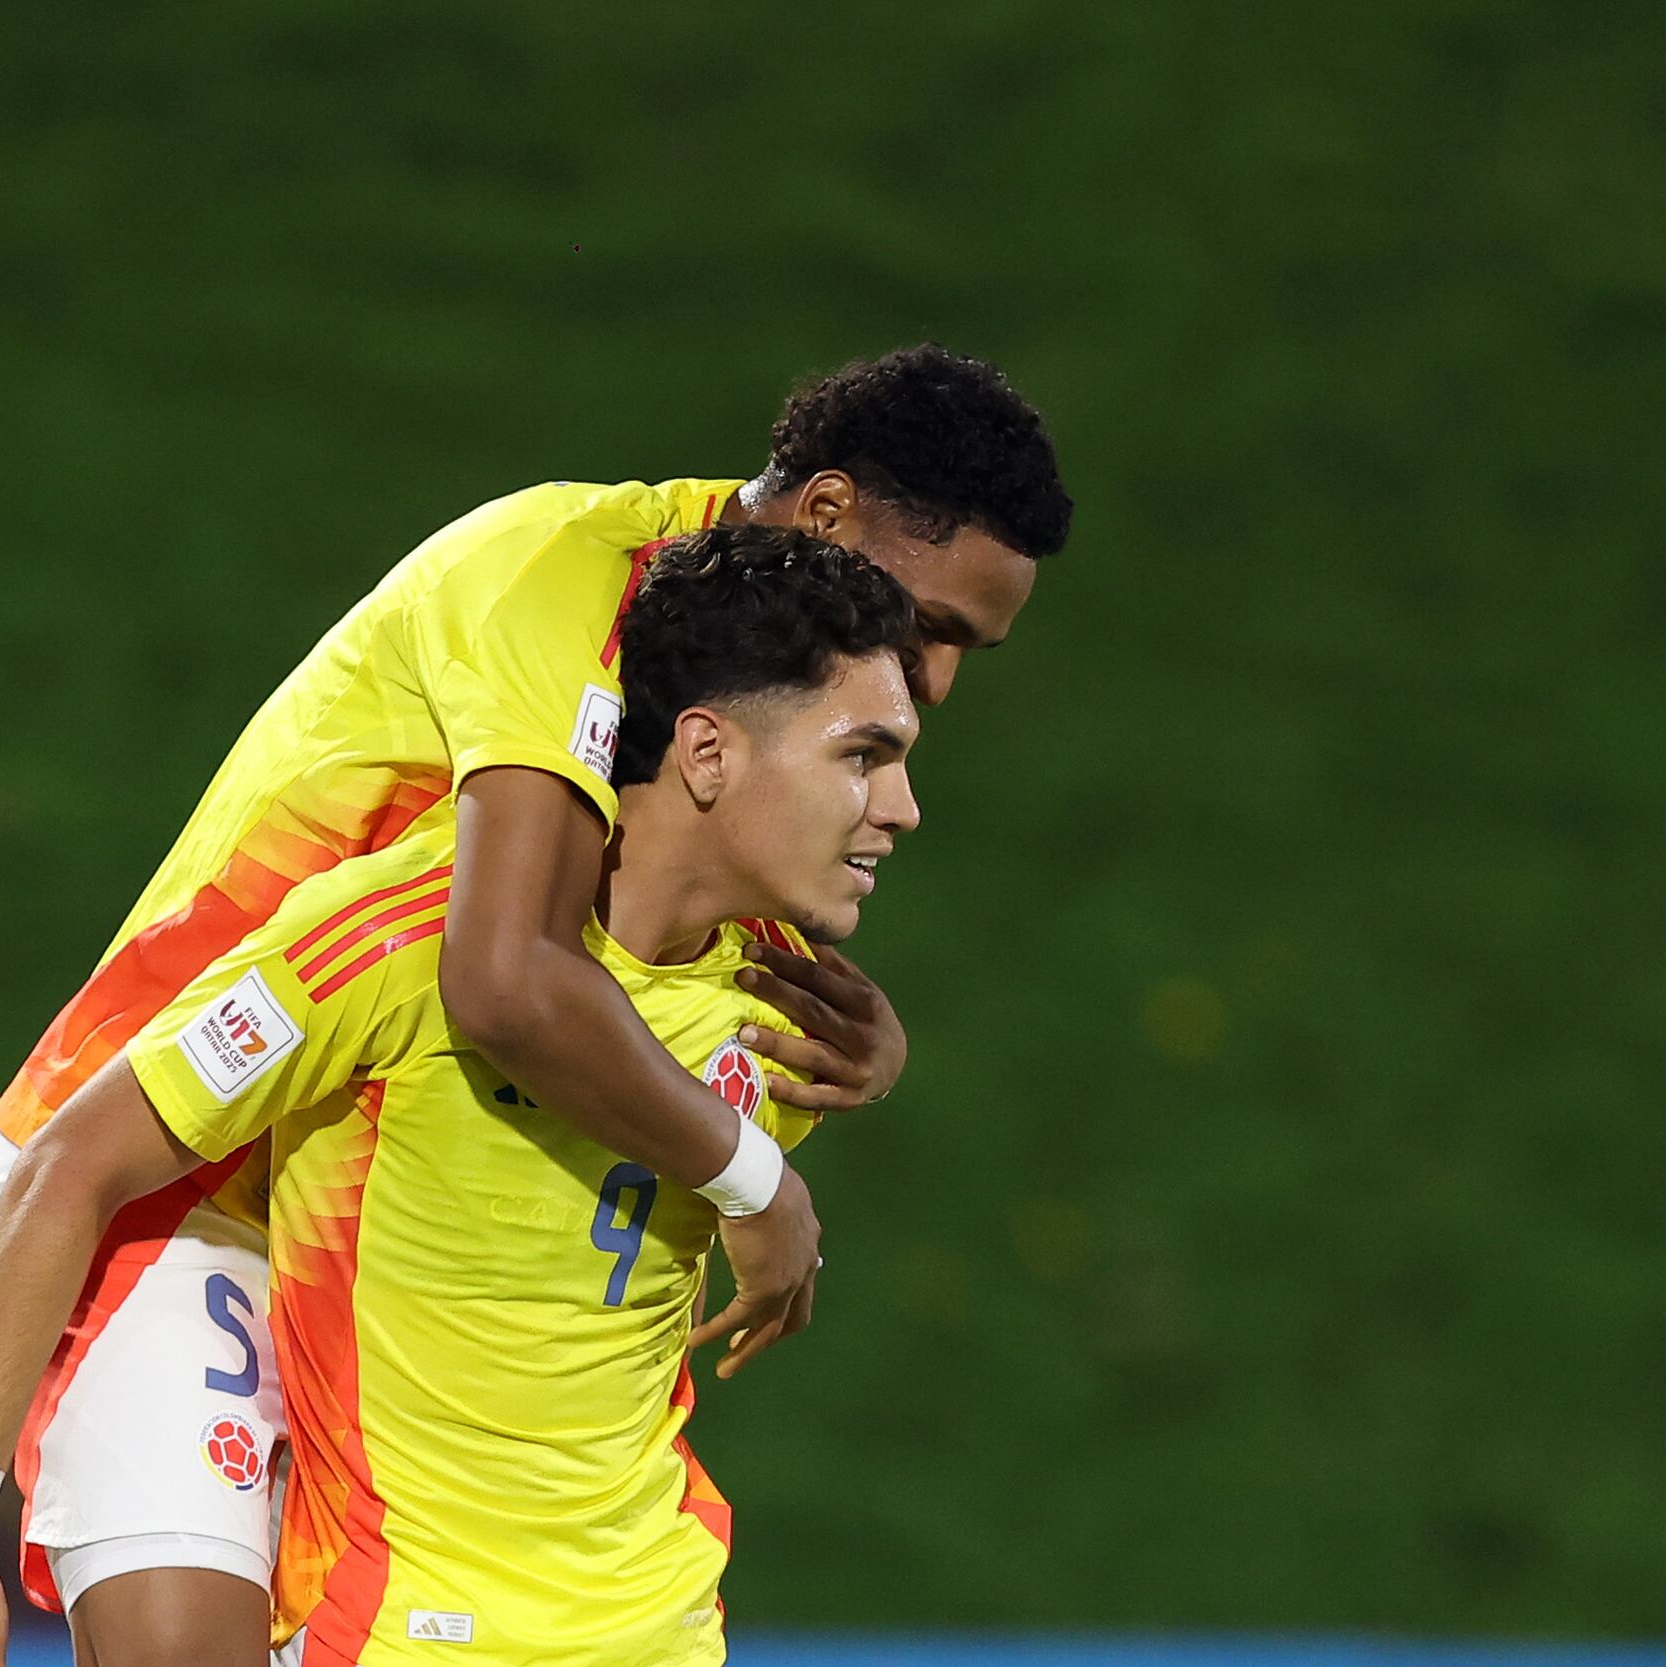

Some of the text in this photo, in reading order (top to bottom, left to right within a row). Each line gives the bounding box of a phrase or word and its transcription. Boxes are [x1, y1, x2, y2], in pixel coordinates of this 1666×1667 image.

[207, 1016, 247, 1069] WORLD CUP
[219, 999, 268, 1056] U17
[244, 1007, 262, 1030] FIFA
[200, 1025, 238, 1073] QATAR 2025
[590, 1162, 657, 1306] 9
